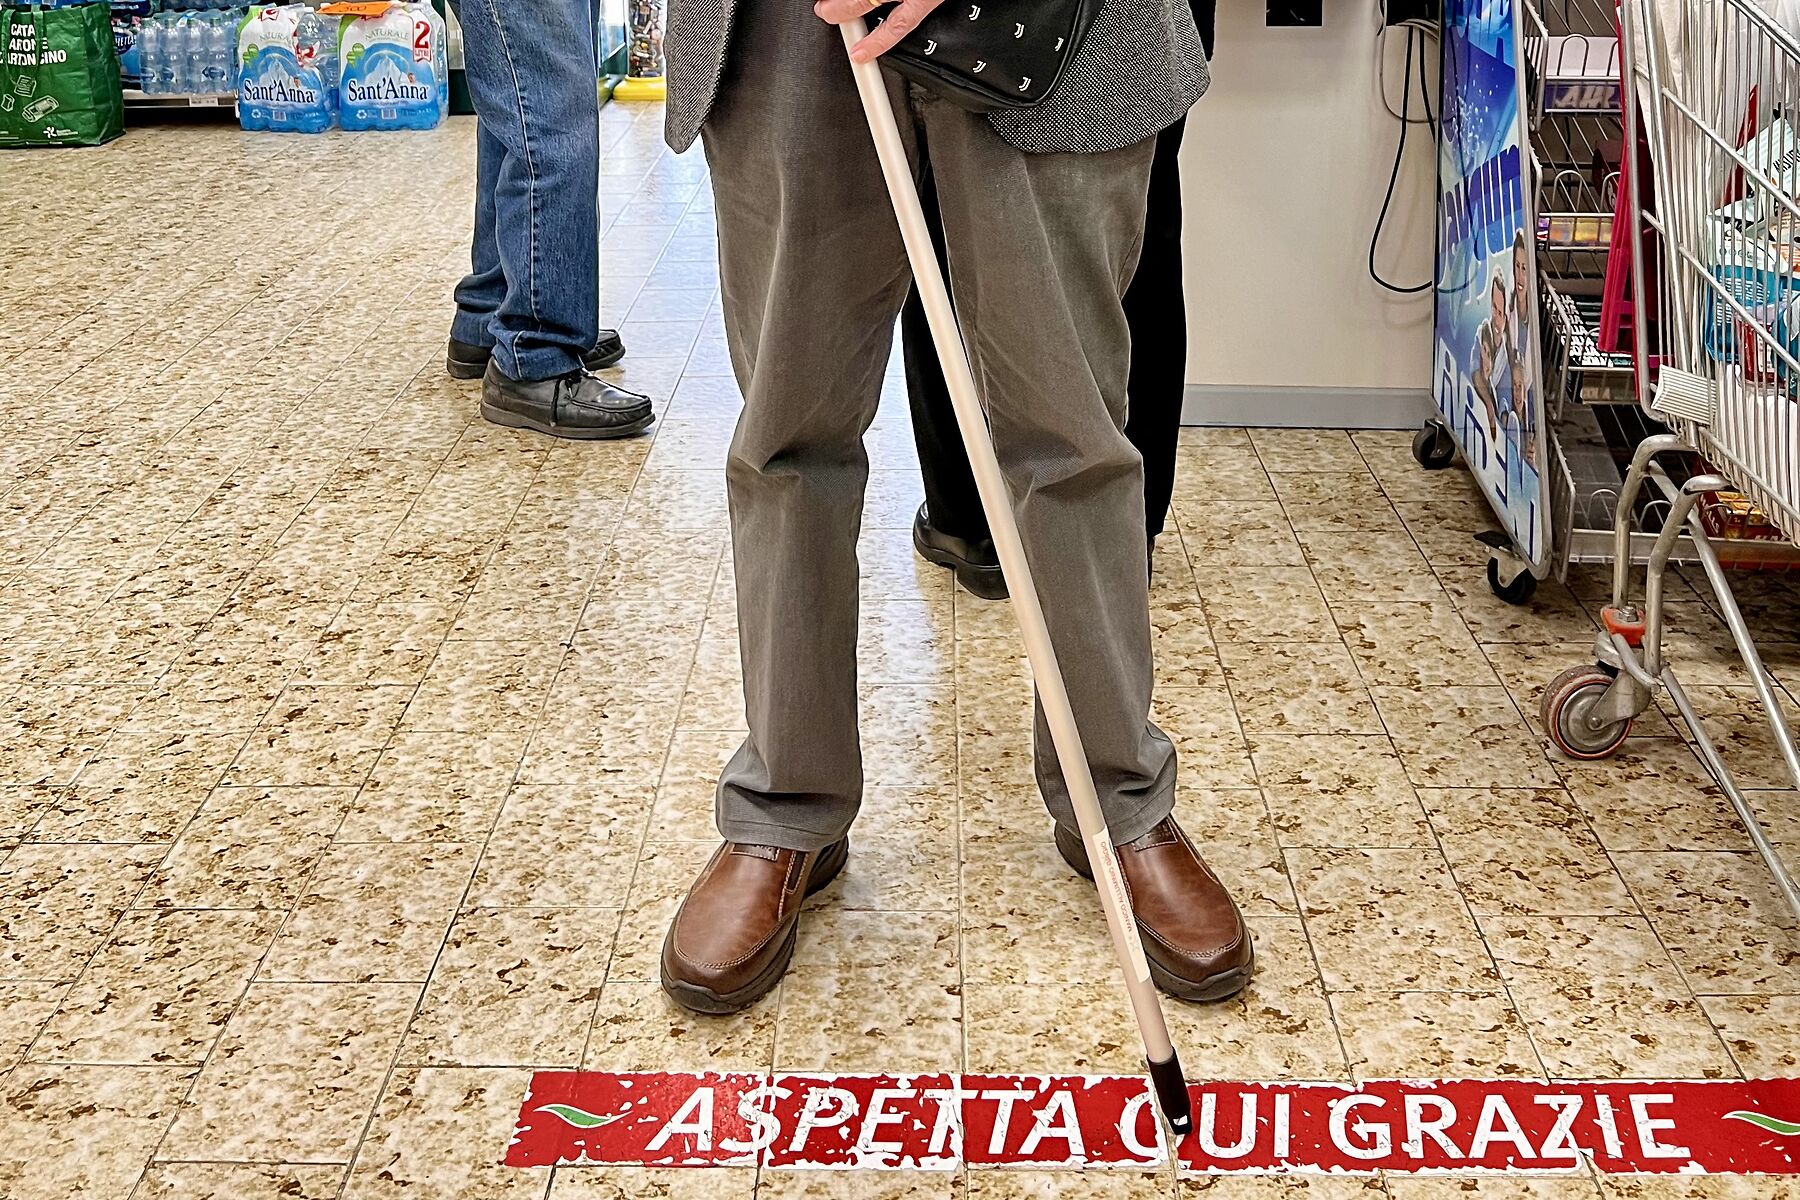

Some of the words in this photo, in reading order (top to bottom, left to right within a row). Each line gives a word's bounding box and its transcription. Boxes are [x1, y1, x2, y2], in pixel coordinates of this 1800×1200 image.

[415, 21, 430, 49] 2
[244, 79, 316, 103] Sant'Anna
[348, 77, 430, 101] Sant'Anna
[644, 1086, 1085, 1155] ASPETTA
[1328, 1092, 1692, 1160] GRAZIE
